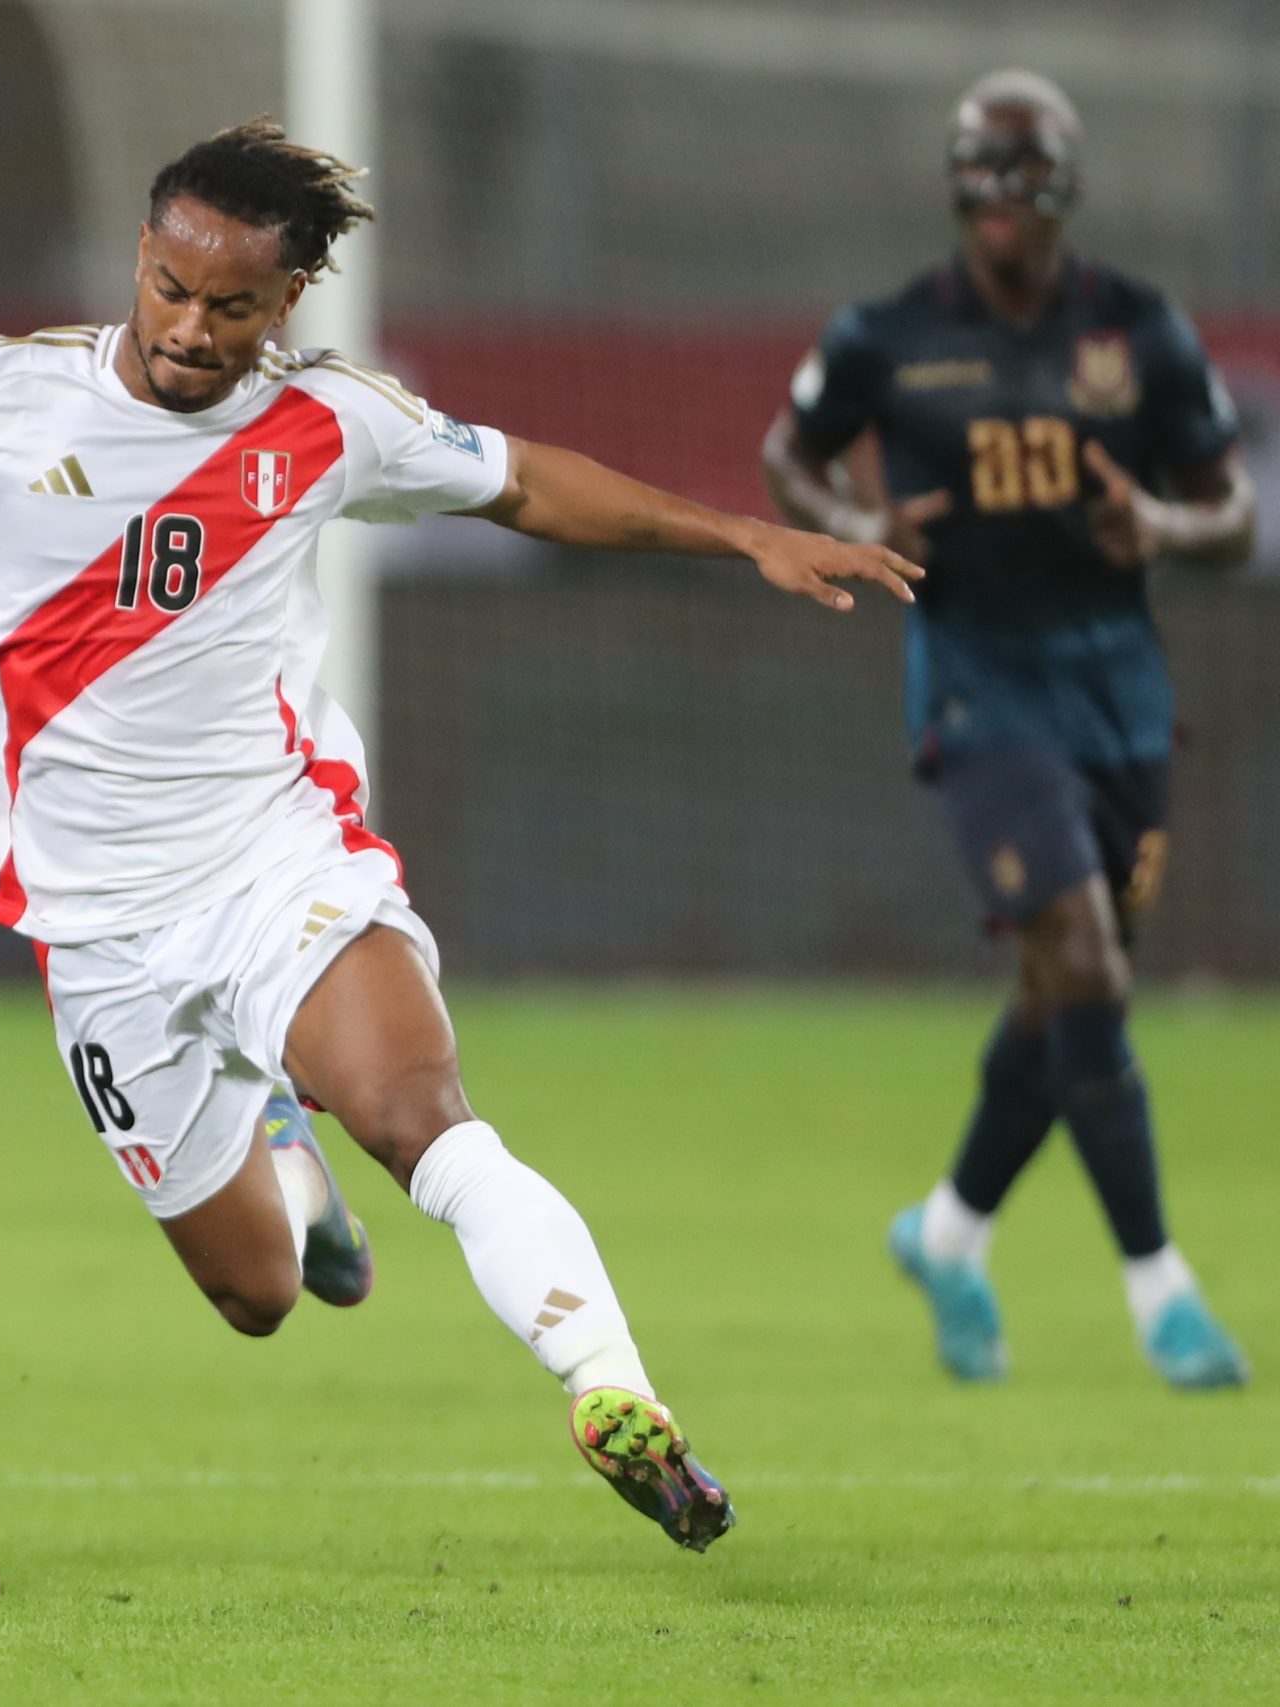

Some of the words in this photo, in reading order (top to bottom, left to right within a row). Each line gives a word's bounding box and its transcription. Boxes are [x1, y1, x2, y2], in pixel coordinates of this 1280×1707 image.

[247, 471, 284, 486] FPF
[114, 511, 204, 614] 18
[70, 1041, 135, 1133] 18
